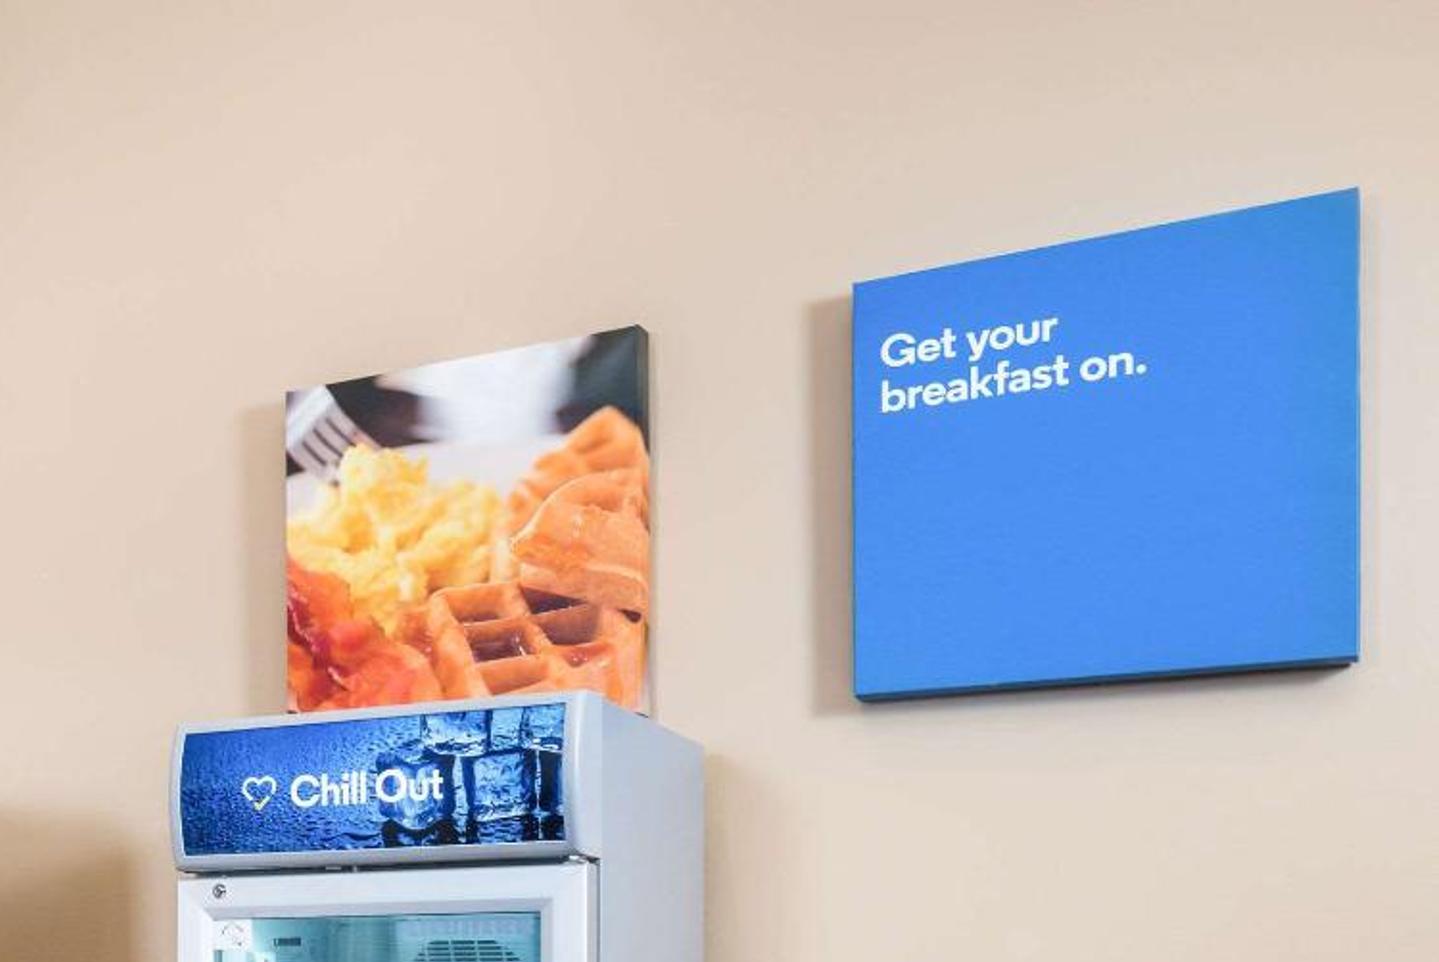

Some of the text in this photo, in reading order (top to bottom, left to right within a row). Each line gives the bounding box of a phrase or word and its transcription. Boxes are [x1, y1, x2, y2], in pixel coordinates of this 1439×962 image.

[879, 317, 1059, 368] Get your
[880, 351, 1148, 414] breakfast on.
[289, 767, 444, 809] Chill Out
